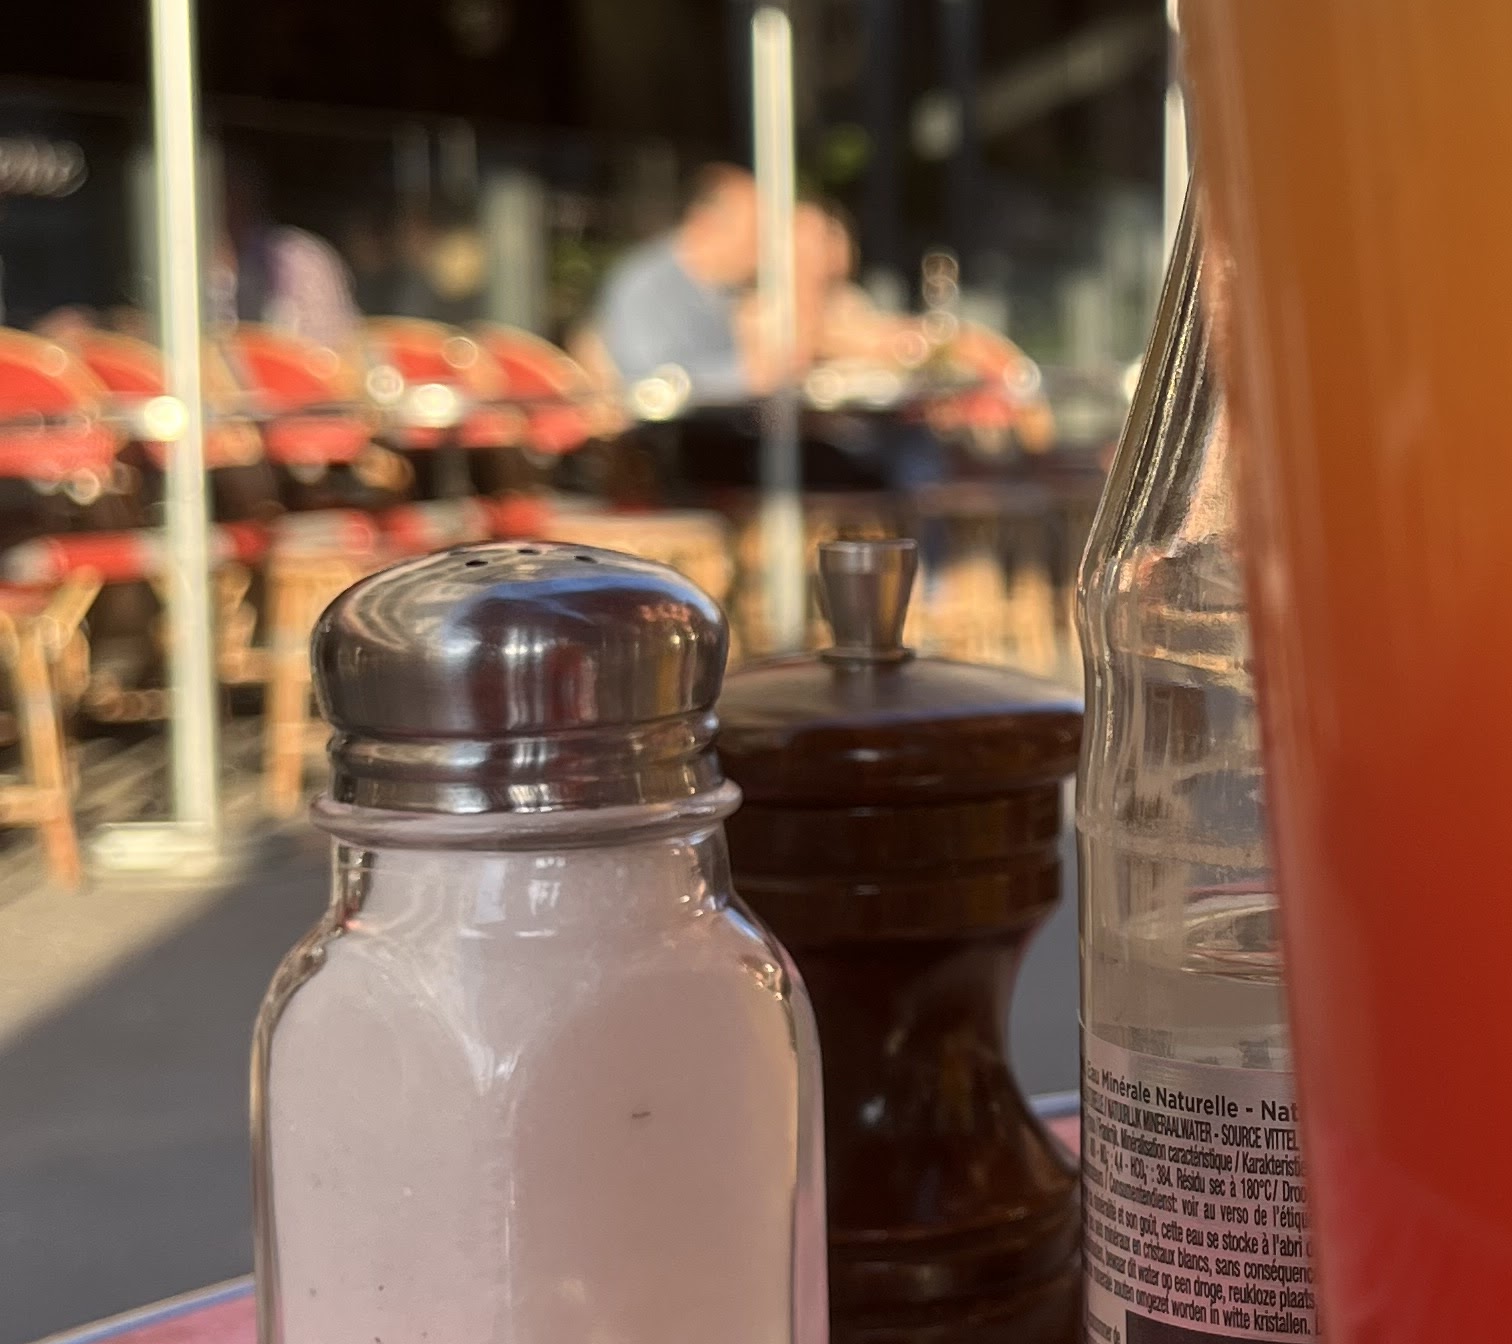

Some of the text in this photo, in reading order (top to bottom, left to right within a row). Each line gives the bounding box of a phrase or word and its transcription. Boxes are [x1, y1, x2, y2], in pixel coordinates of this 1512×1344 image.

[1101, 1069, 1151, 1104] Minérale
[1156, 1086, 1239, 1118] Naturelle
[1143, 1109, 1212, 1144] MINERAALWATER
[1221, 1123, 1262, 1149] SOURCE
[1168, 1143, 1233, 1175] caractéristique
[1176, 1166, 1206, 1193] Résidu
[1209, 1177, 1226, 1196] sec
[1230, 1175, 1237, 1197] à
[1182, 1195, 1199, 1217] voir
[1203, 1201, 1216, 1220] au
[1220, 1204, 1249, 1224] verso
[1253, 1203, 1267, 1226] de
[1125, 1210, 1138, 1231] son
[1139, 1212, 1160, 1241] goût,
[1161, 1220, 1184, 1243] cette
[1186, 1227, 1204, 1247] eau
[1206, 1231, 1219, 1249] se
[1222, 1230, 1259, 1254] stocke
[1262, 1232, 1270, 1255] à
[1272, 1234, 1303, 1258] l'abri
[1132, 1238, 1142, 1256] en
[1143, 1238, 1176, 1266] cristaux
[1178, 1246, 1212, 1277] blancs,
[1215, 1257, 1241, 1277] sans
[1138, 1263, 1160, 1287] water
[1161, 1272, 1172, 1298] op
[1174, 1275, 1192, 1295] een
[1193, 1276, 1226, 1305] droge,
[1228, 1282, 1277, 1307] reukloze
[1279, 1286, 1315, 1312] plaats
[1136, 1288, 1170, 1314] omgezet
[1171, 1299, 1207, 1323] worden
[1210, 1304, 1220, 1325] in
[1222, 1305, 1251, 1330] witte
[1253, 1308, 1311, 1335] kristallen.
